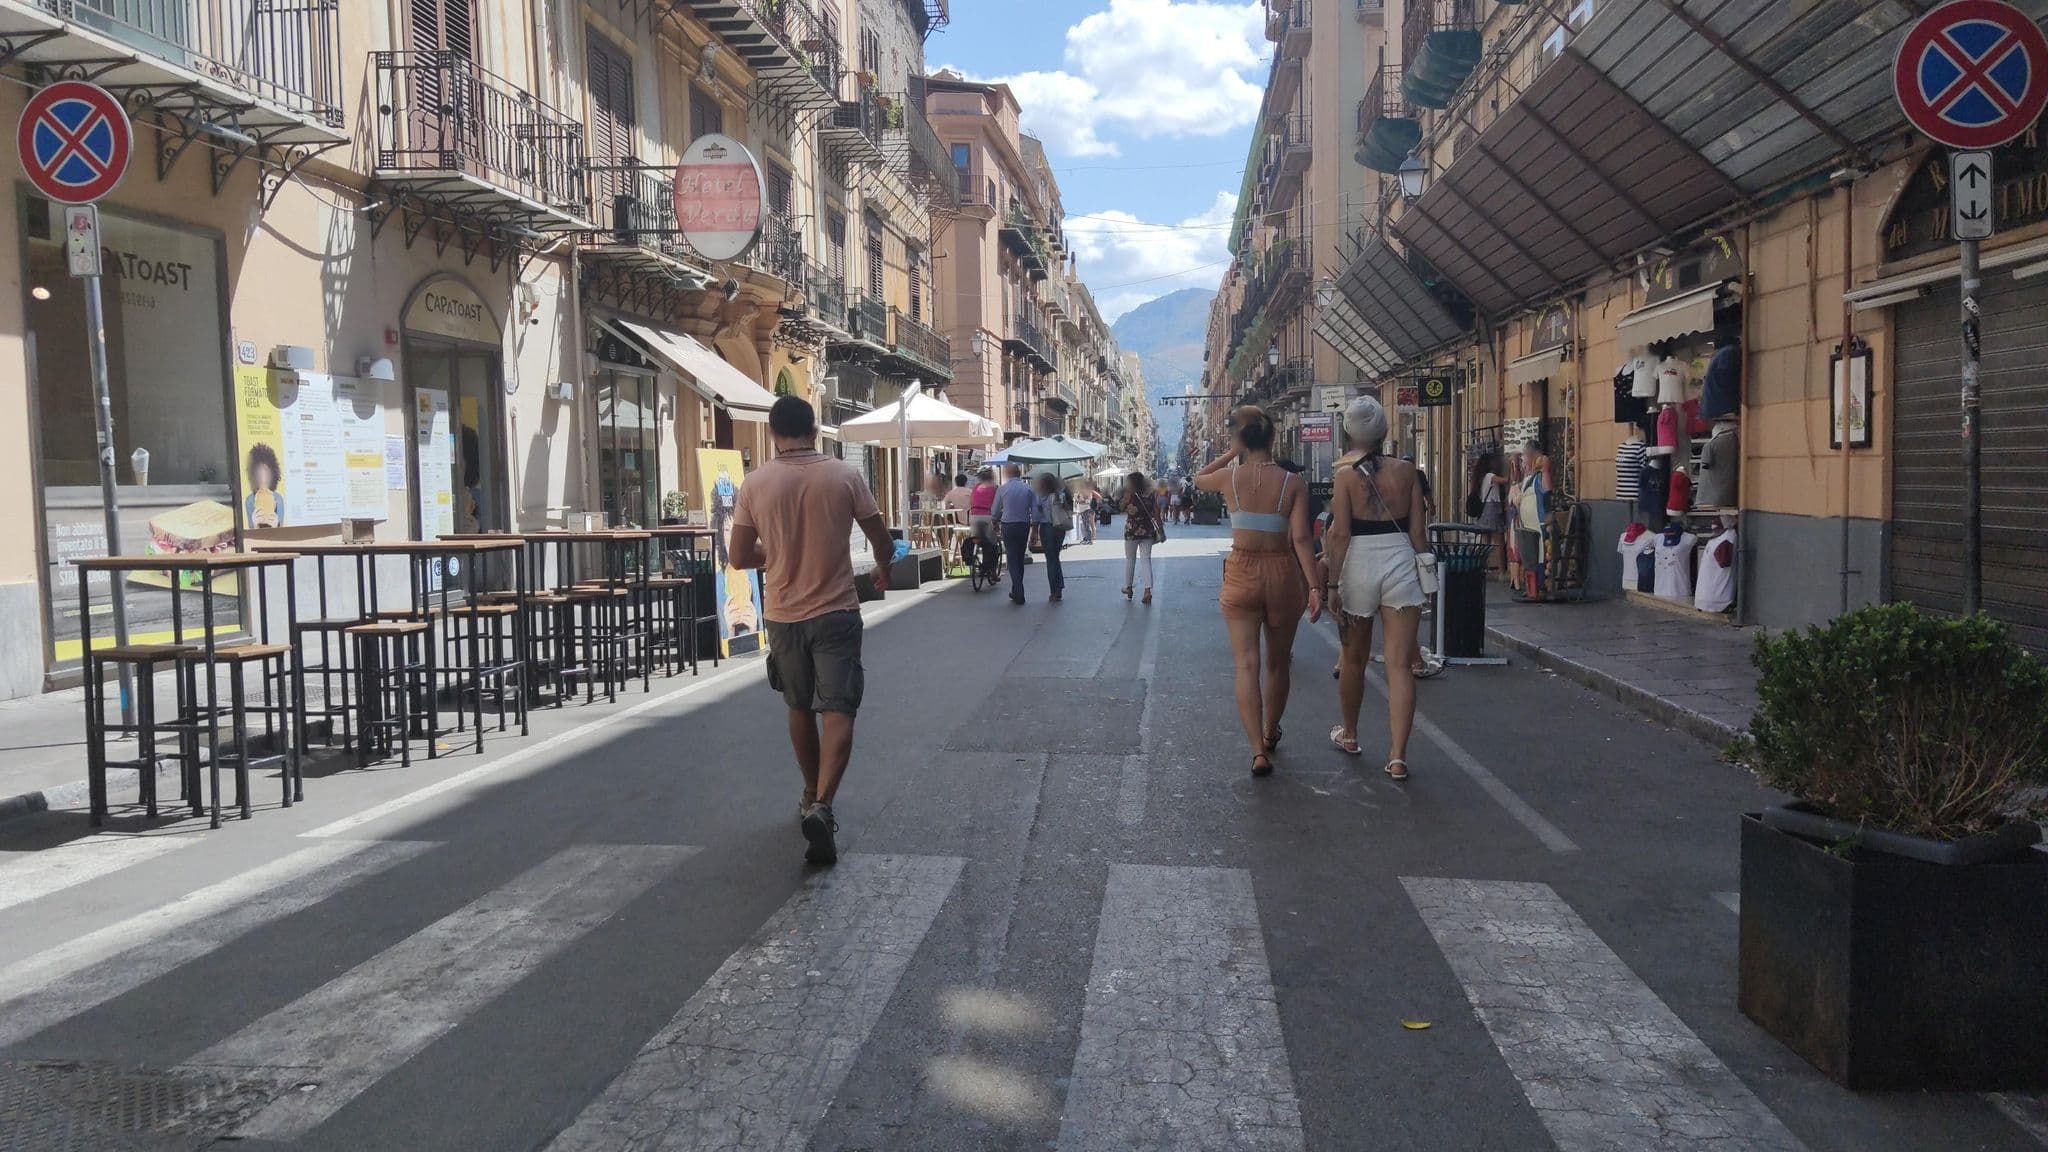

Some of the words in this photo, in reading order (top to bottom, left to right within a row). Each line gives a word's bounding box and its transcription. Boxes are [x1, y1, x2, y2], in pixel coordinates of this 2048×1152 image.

[678, 170, 752, 195] Hotel
[425, 292, 482, 322] CAPATOAST
[241, 345, 256, 360] 423
